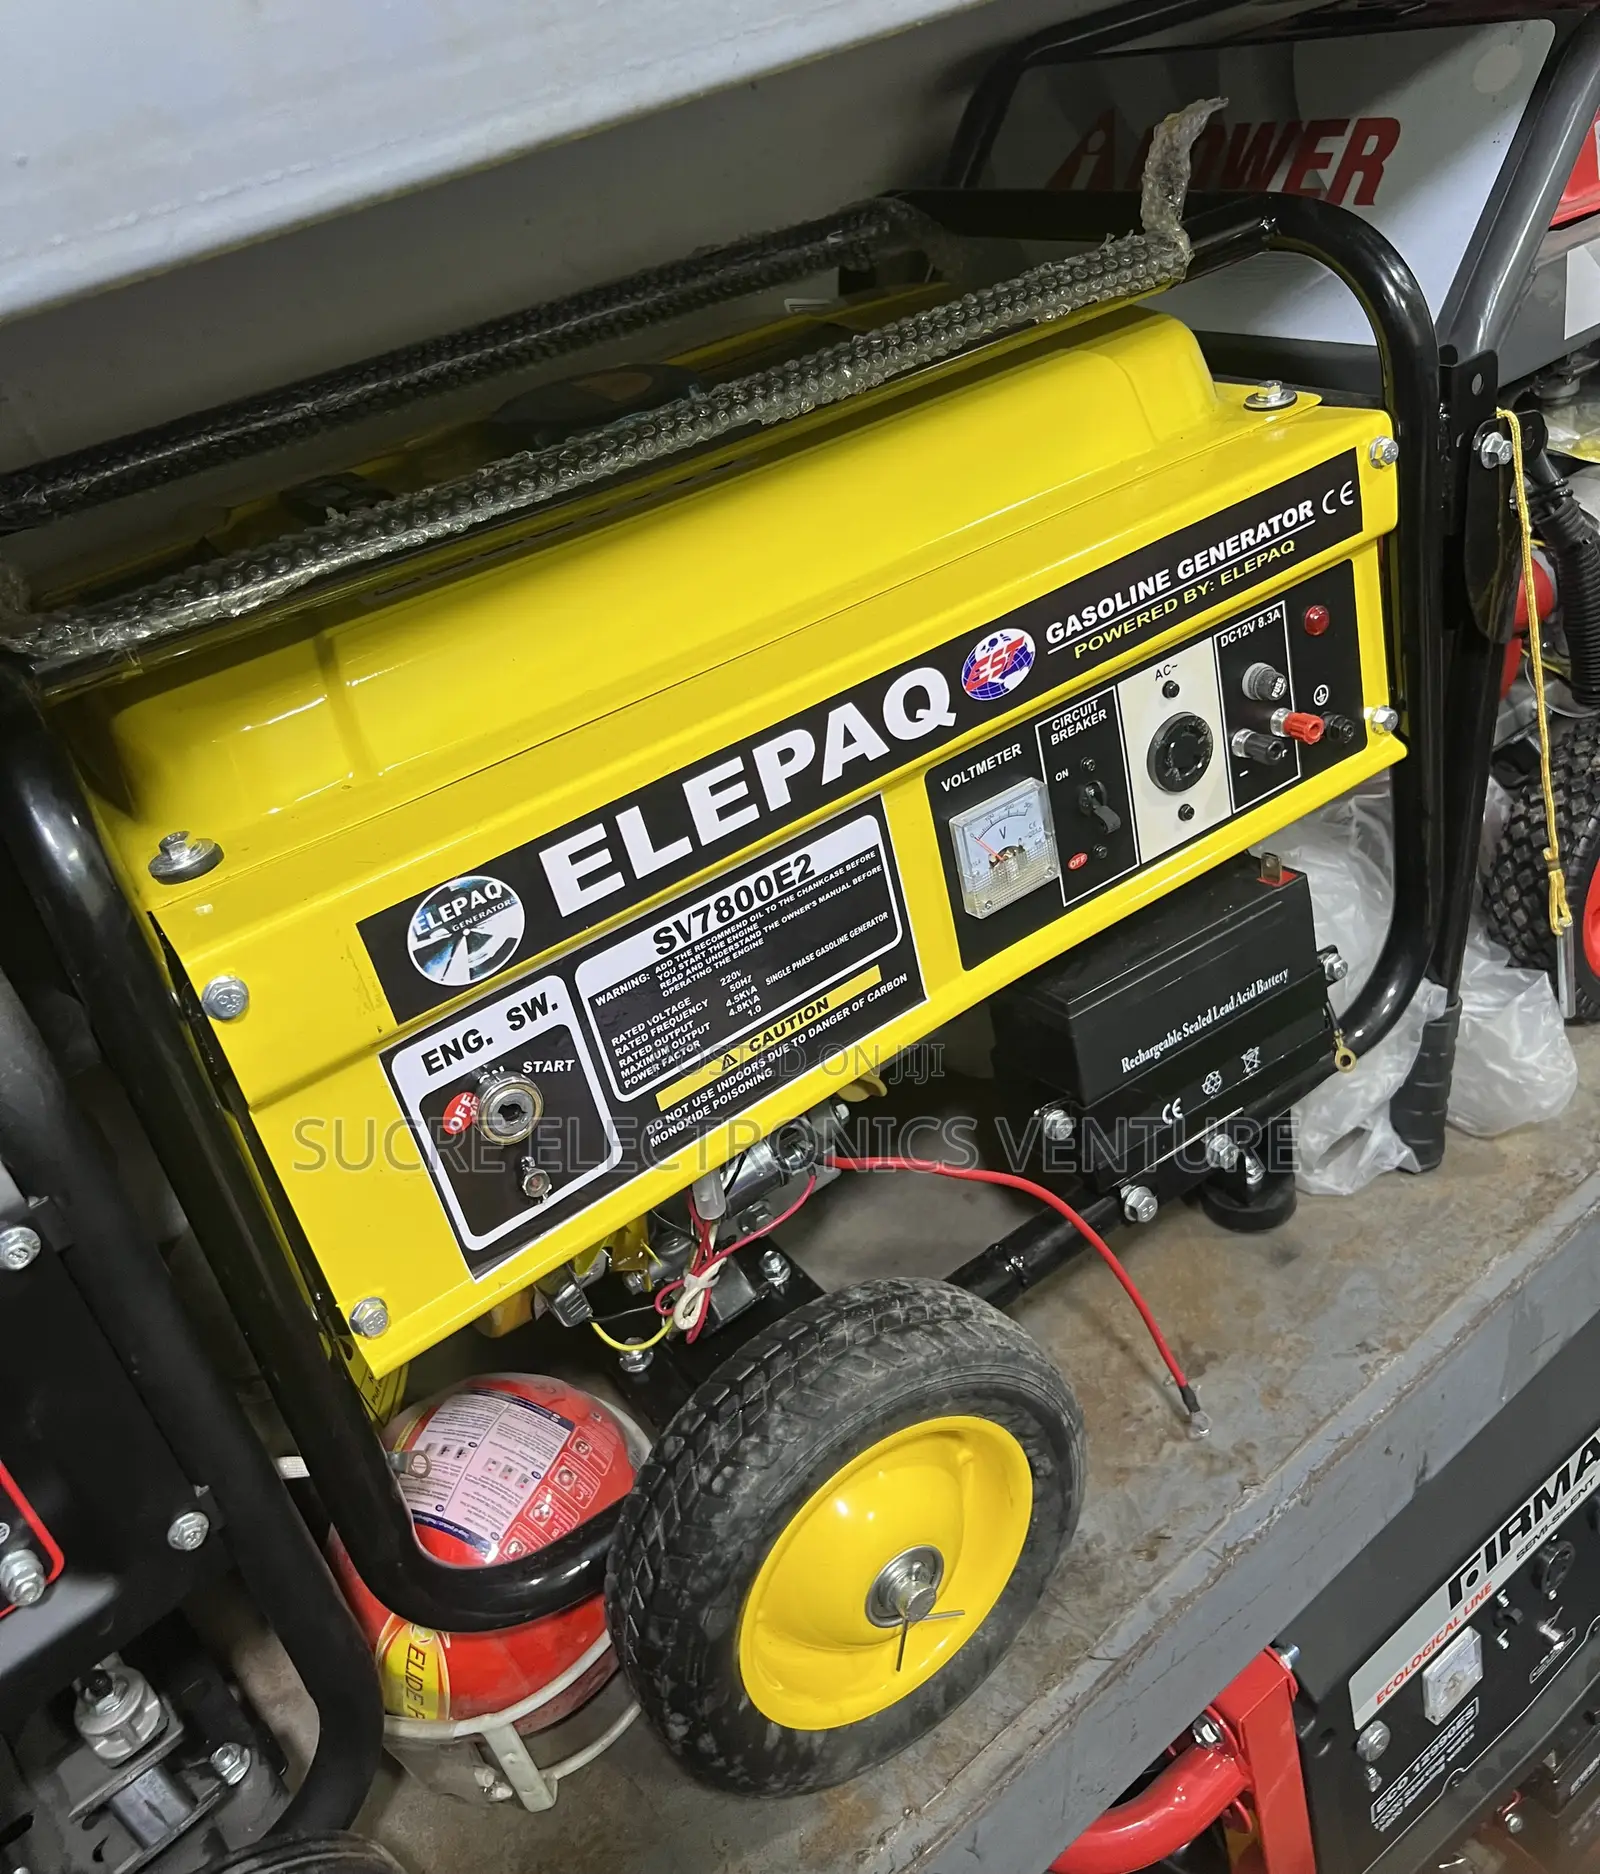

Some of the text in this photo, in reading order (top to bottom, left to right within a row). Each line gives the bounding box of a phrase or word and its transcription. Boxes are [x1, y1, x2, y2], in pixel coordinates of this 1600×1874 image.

[1046, 569, 1171, 644] GASOLINE
[1177, 500, 1314, 580] GENERATOR
[1074, 539, 1295, 659] POWERED BY: ELEPAQ
[966, 635, 1025, 692] EST
[1220, 608, 1281, 648] DC12V 8.3A
[1052, 700, 1098, 731] CIRCUIT
[1272, 677, 1284, 698] FUSE
[1051, 709, 1107, 745] BREAKER
[539, 667, 956, 918] ELEPAQ
[940, 743, 1023, 793] VOLTMETER
[1055, 769, 1069, 782] ON
[999, 826, 1006, 839] V
[1070, 855, 1085, 869] OFF
[413, 880, 503, 936] ELEPAQ
[452, 896, 518, 931] GENERATORS
[653, 853, 815, 955] SV7800E2
[655, 850, 875, 974] ADD THE RECOMMEND OIL TO THE CHANKCASE BEFORE
[660, 864, 883, 990] READ AND UNDERSTAND THE OWNER'S MANUAL BEFORE
[657, 923, 759, 981] YOU START THE ENGINE
[662, 938, 764, 998] OPERATING THE ENGINE
[766, 911, 888, 986] SINGLE PHASE GASOLINE GENERATOR
[595, 972, 650, 1007] WARNING:
[611, 969, 742, 1047] RATED VOLTAGE 220V
[614, 974, 752, 1057] RATED FREQUENCY 50HZ
[618, 985, 758, 1068] RATED OUTPUT 4.5KVA
[749, 997, 829, 1052] CAUTION
[1121, 968, 1289, 1073] Rechargeable Sealed Lead Acid Battery
[421, 1029, 494, 1076] ENG.
[506, 992, 559, 1031] SW.
[523, 1059, 575, 1073] START
[620, 994, 760, 1079] MAXIMUM OUTPUT 4.8KVA
[623, 1005, 762, 1089] POWER FACTOR 1.0
[646, 973, 908, 1136] DO NOT USE INDOORS DUE TO DANGER OF CARBON
[450, 1093, 472, 1132] OFF
[650, 1067, 773, 1148] MONOXIDE POISONING
[1516, 1475, 1595, 1561] SEMI-SILENT
[405, 1643, 426, 1706] ELIDE
[1376, 1581, 1492, 1705] ECOLOGICAL LINE
[1376, 1776, 1408, 1813] ECO
[1412, 1706, 1475, 1773] 12990ES
